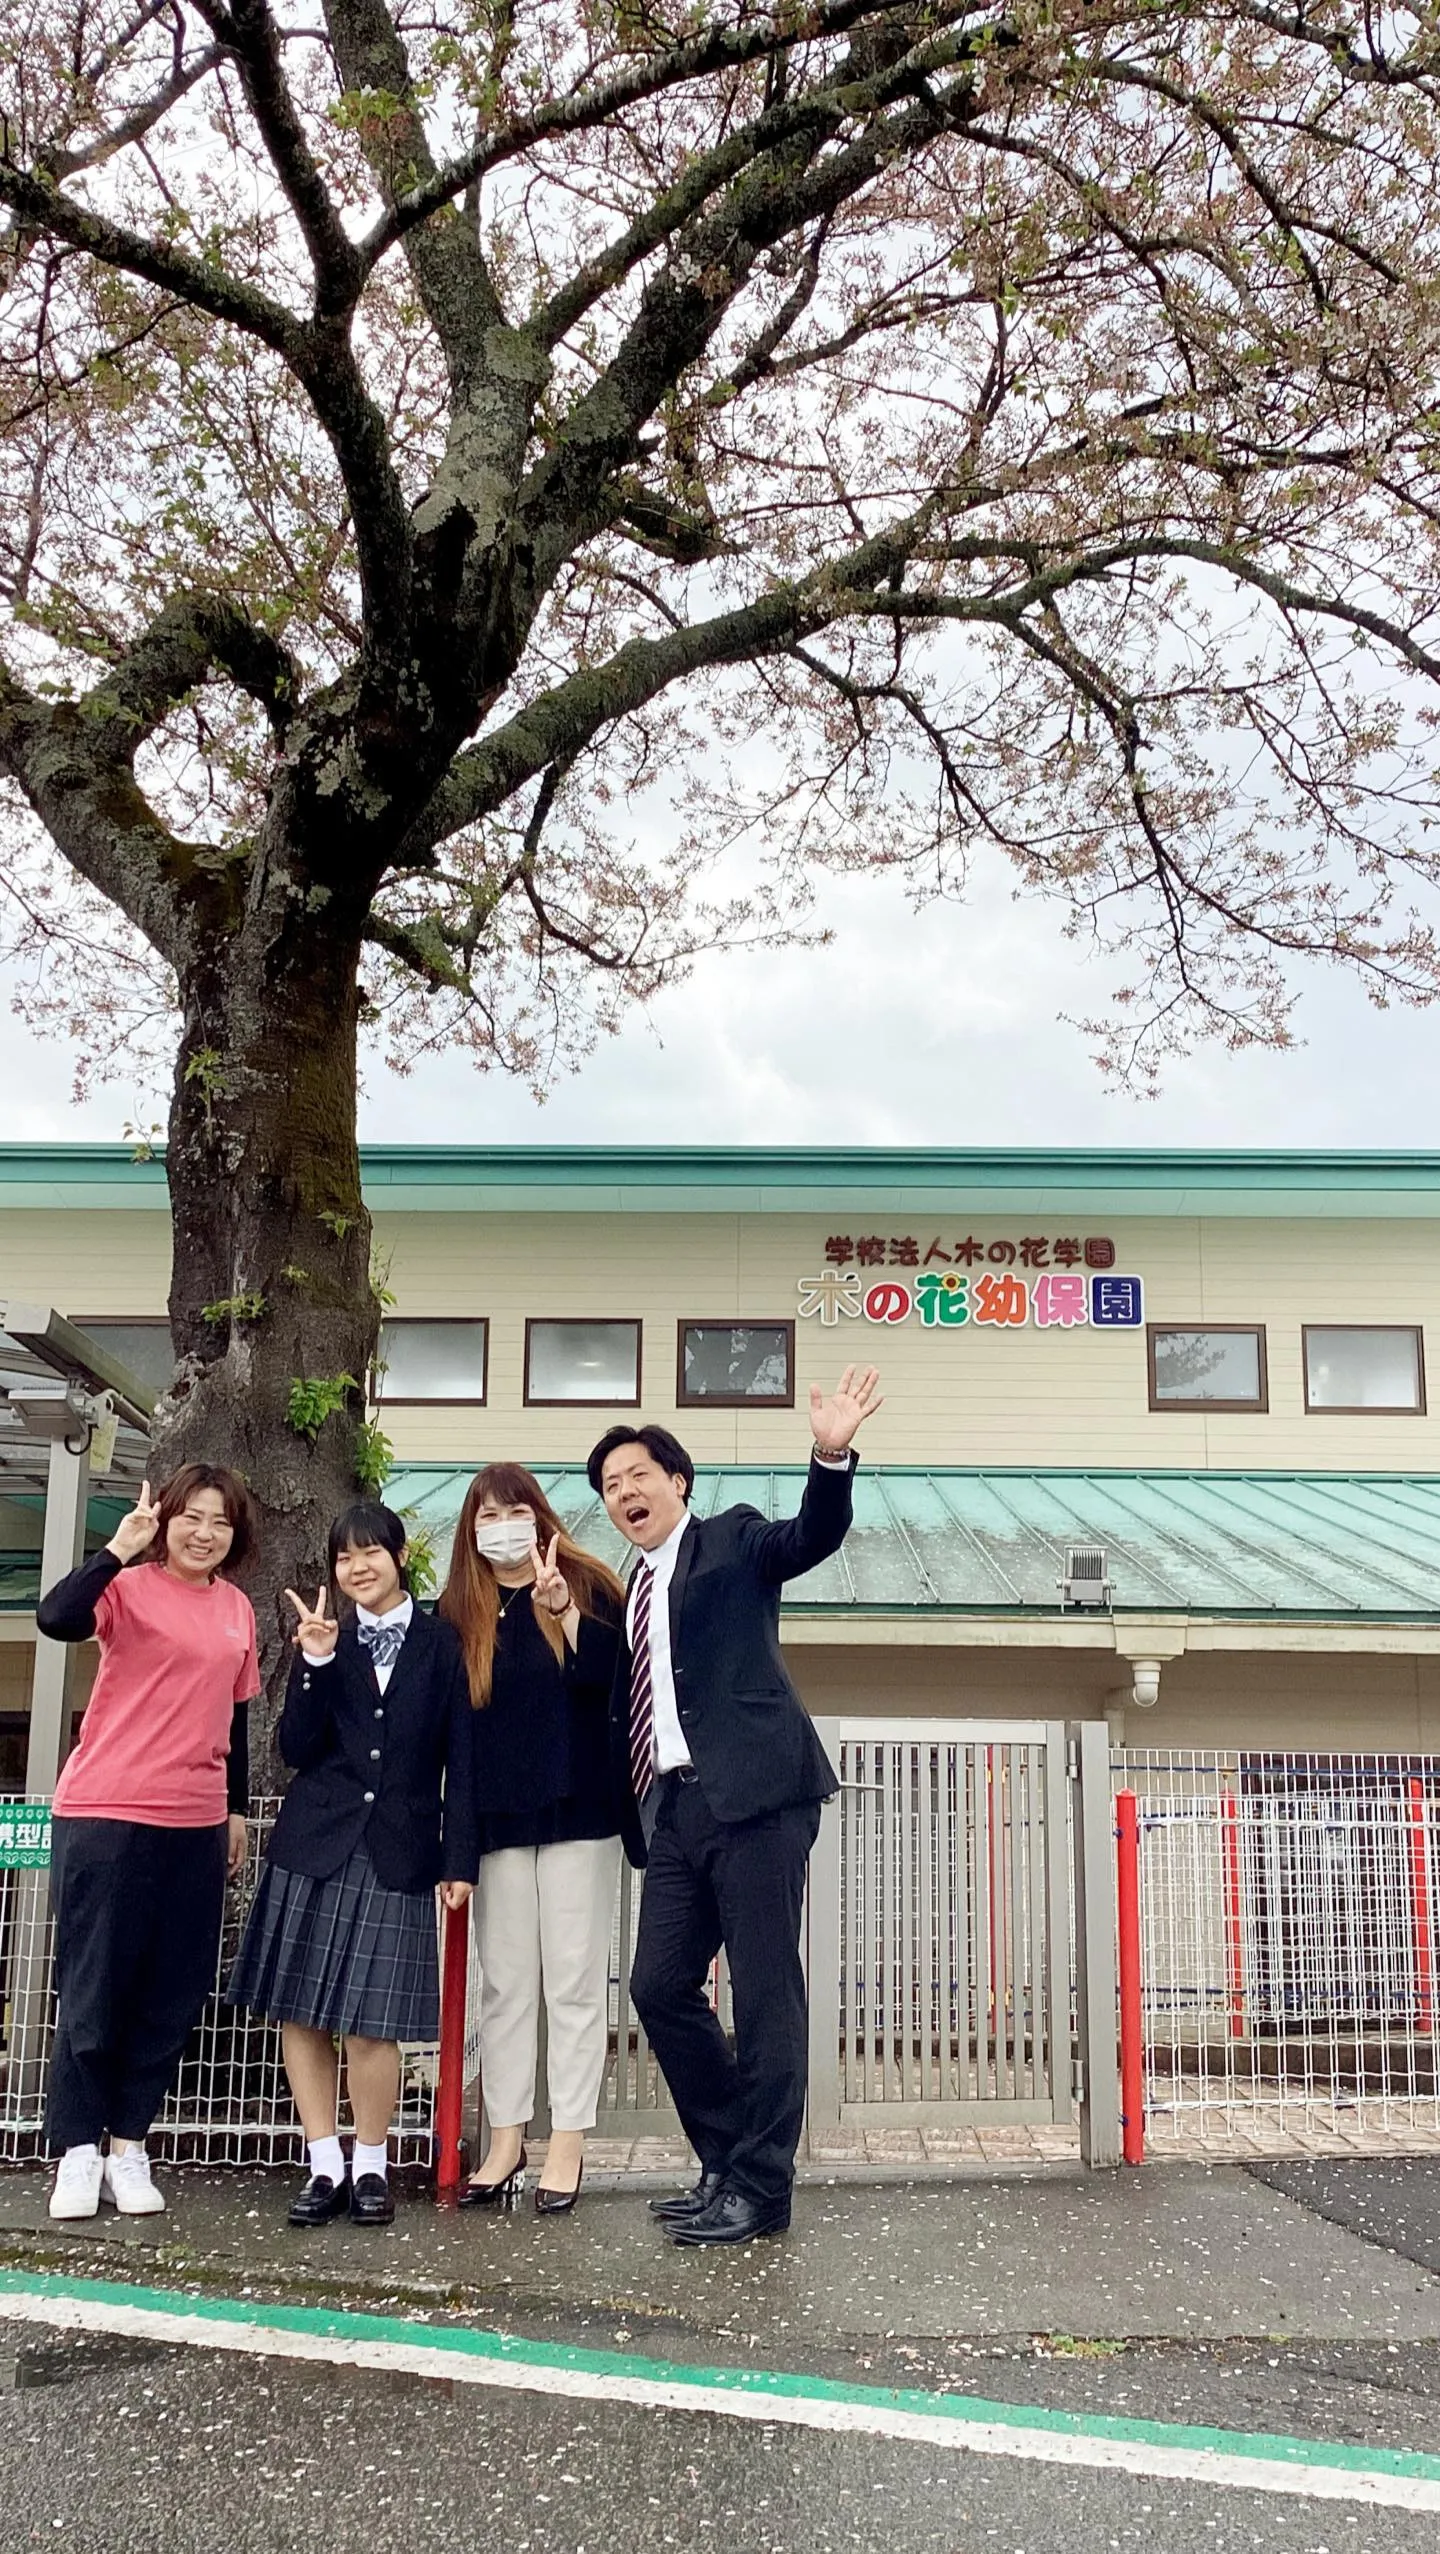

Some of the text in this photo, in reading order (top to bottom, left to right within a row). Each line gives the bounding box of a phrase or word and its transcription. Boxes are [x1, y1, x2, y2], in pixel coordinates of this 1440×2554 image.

[825, 1236, 1115, 1268] 学校法人木の花学園
[799, 1270, 1144, 1327] 木の花幼保園
